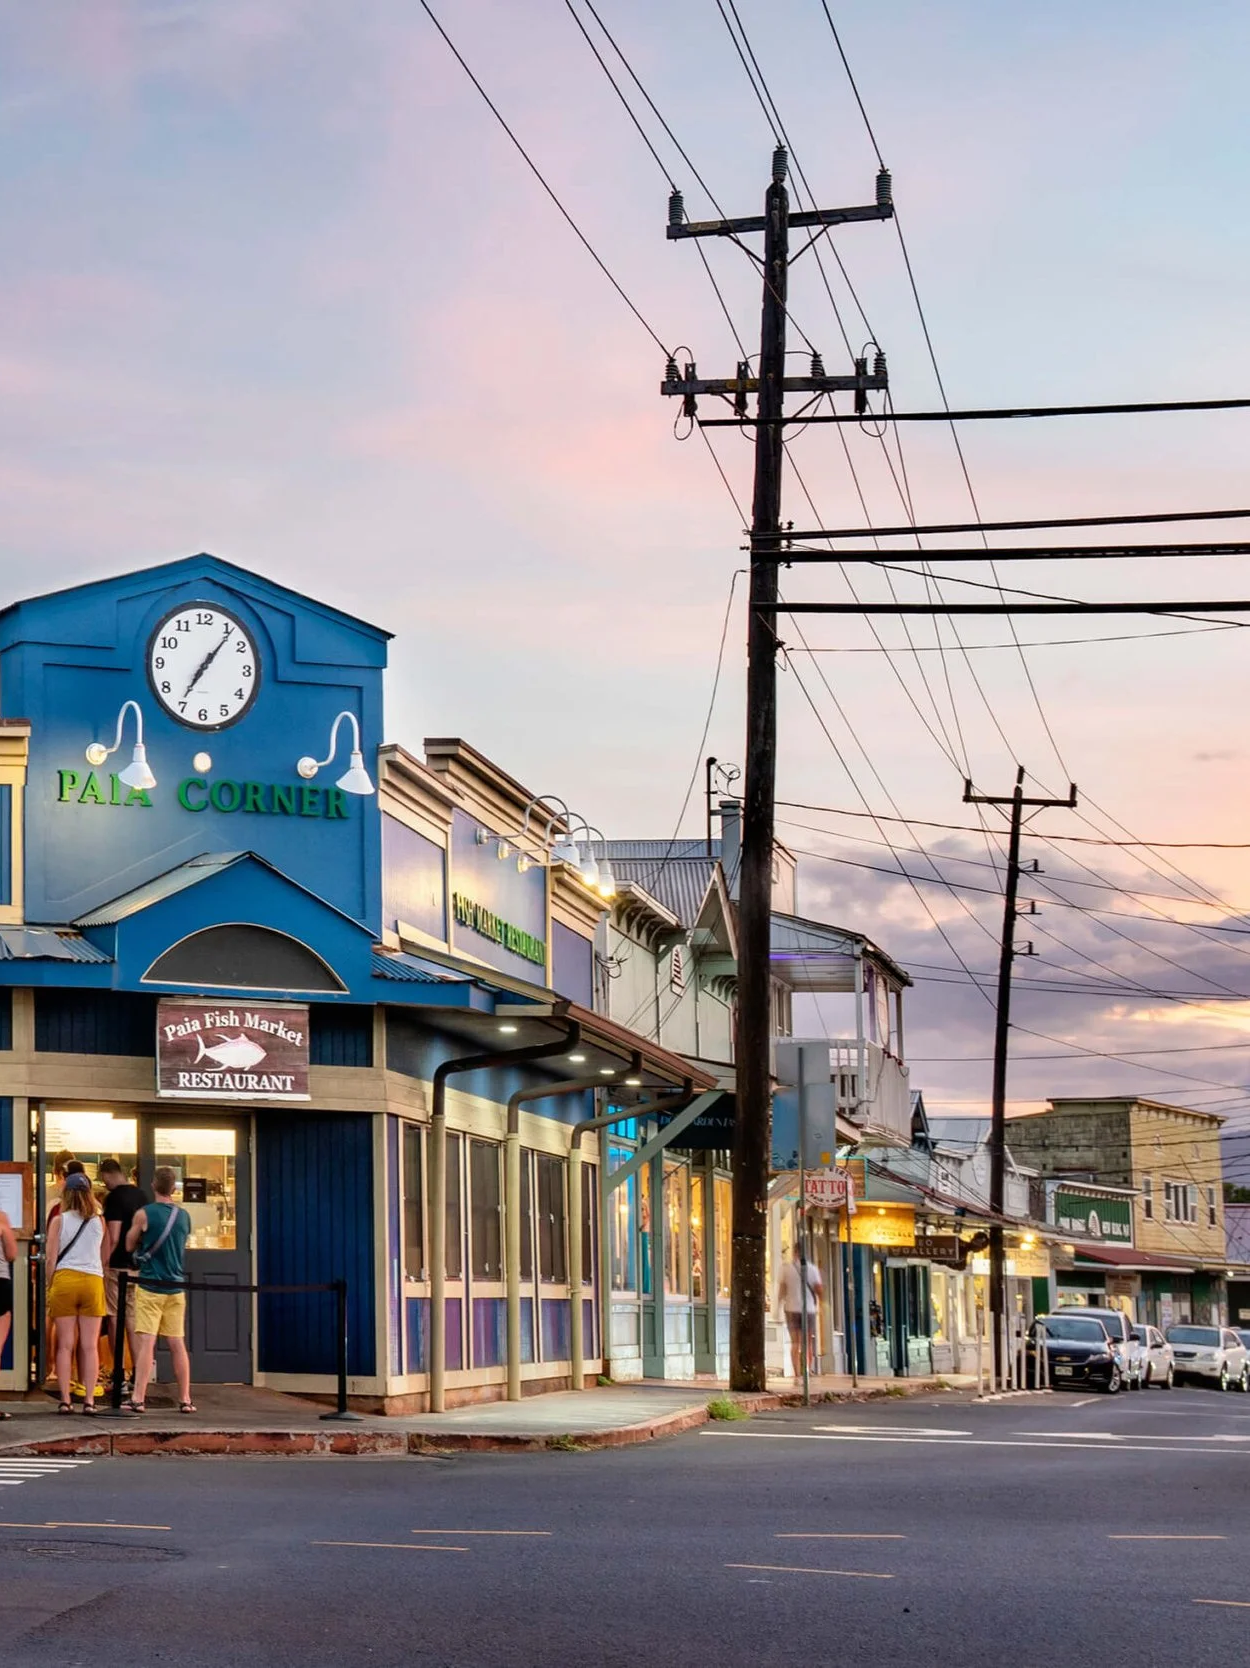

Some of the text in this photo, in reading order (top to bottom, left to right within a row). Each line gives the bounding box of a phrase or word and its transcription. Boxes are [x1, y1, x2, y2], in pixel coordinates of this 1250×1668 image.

[196, 613, 213, 626] 12
[175, 620, 191, 632] 11
[222, 622, 230, 634] 1
[161, 637, 178, 649] 10
[236, 641, 246, 653] 2
[155, 657, 165, 669] 9
[242, 665, 251, 677] 3
[161, 681, 171, 693] 8
[234, 688, 244, 700] 4
[178, 701, 188, 713] 7
[219, 704, 229, 717] 5
[198, 709, 208, 721] 6
[57, 769, 349, 819] PAIA CORNER
[164, 1010, 304, 1047] Paia Fish Market
[178, 1072, 295, 1091] RESTAURANT
[805, 1178, 847, 1194] TATTO
[902, 1247, 954, 1256] GALLERY
